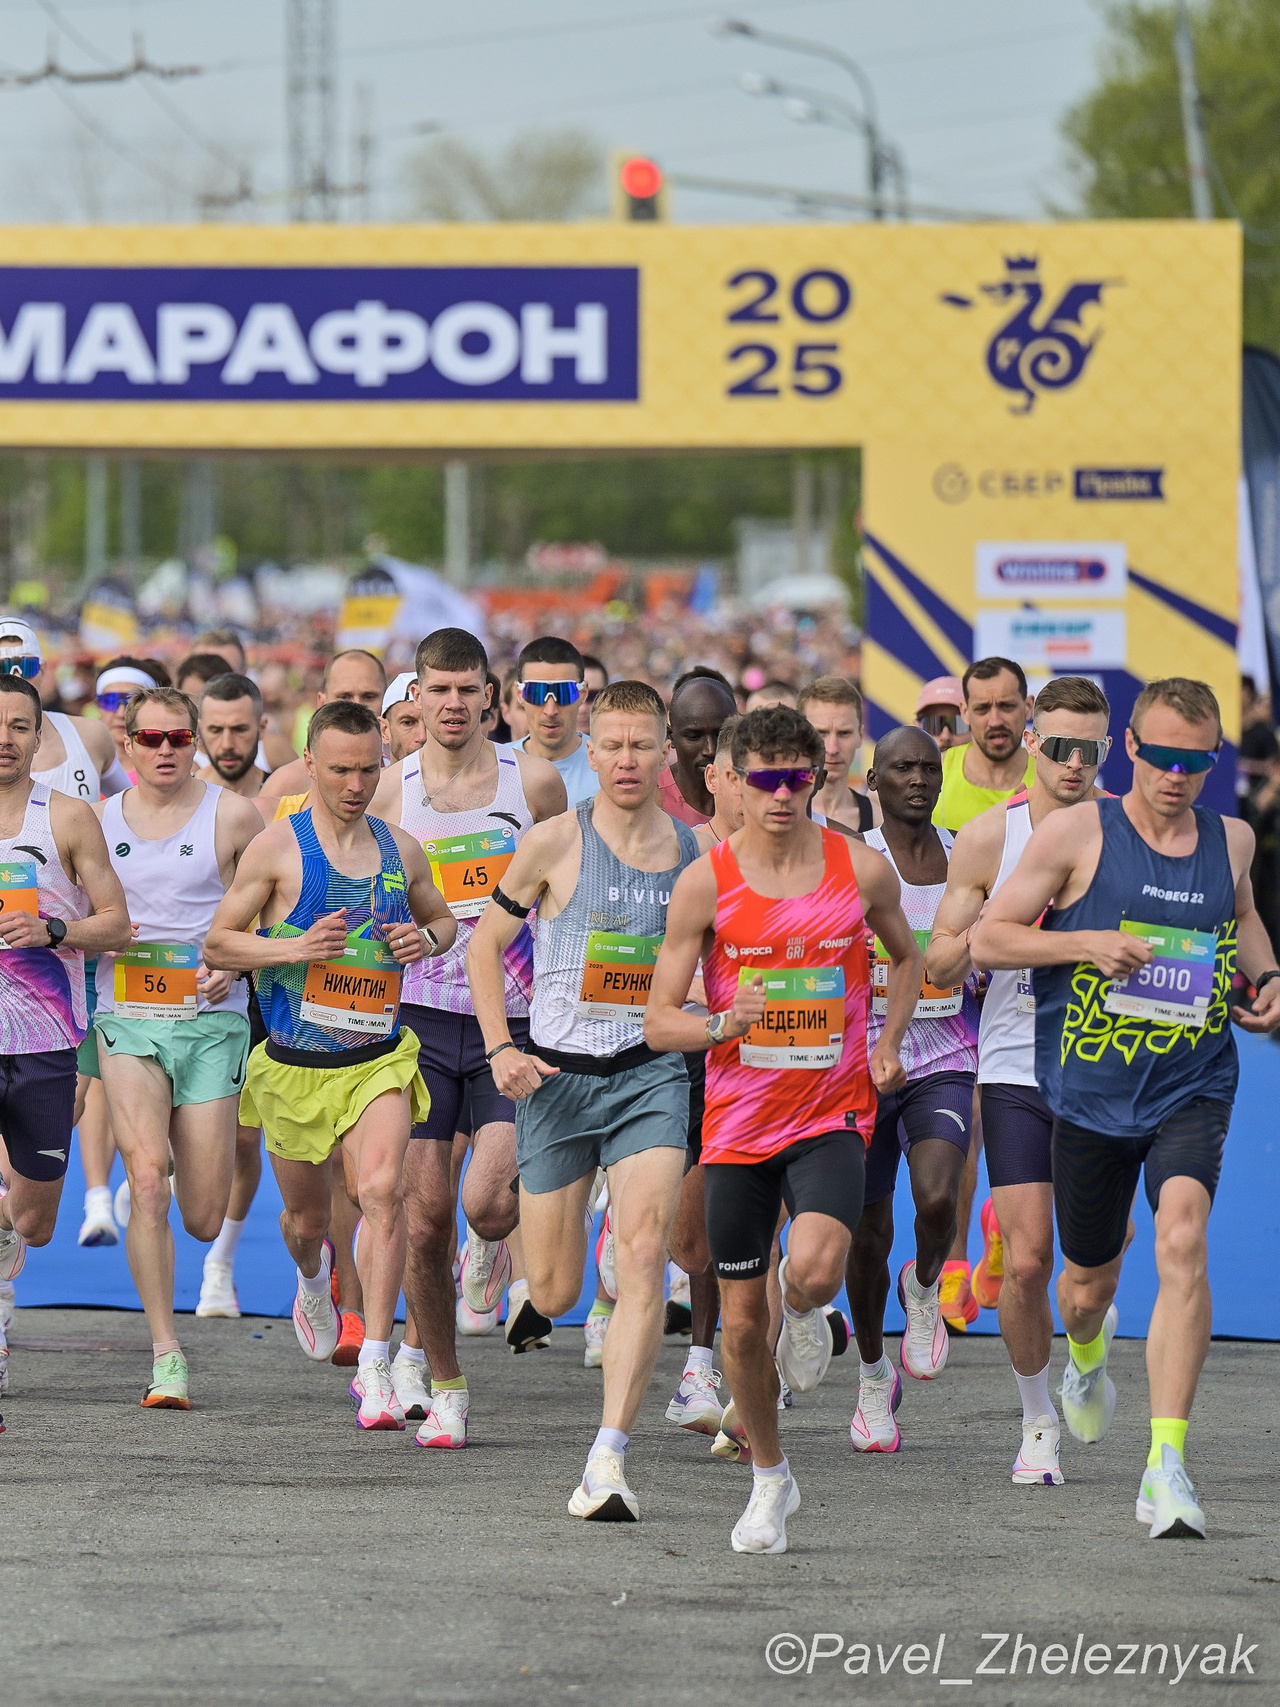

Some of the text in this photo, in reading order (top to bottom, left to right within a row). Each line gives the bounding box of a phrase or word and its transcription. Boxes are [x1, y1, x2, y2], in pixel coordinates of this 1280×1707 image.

[727, 269, 853, 324] 20
[727, 343, 843, 398] 25
[463, 866, 488, 887] 45
[1142, 884, 1205, 904] PROBEG 22
[818, 936, 853, 949] FONBET
[144, 975, 166, 993] 56
[324, 973, 387, 999] НИКИТИН
[1138, 964, 1191, 992] 5010
[350, 1001, 356, 1011] 4
[630, 996, 635, 1005] 1
[756, 1009, 827, 1033] НЕДЕЛИН
[788, 1036, 795, 1047] 2
[719, 1258, 761, 1271] FONBET
